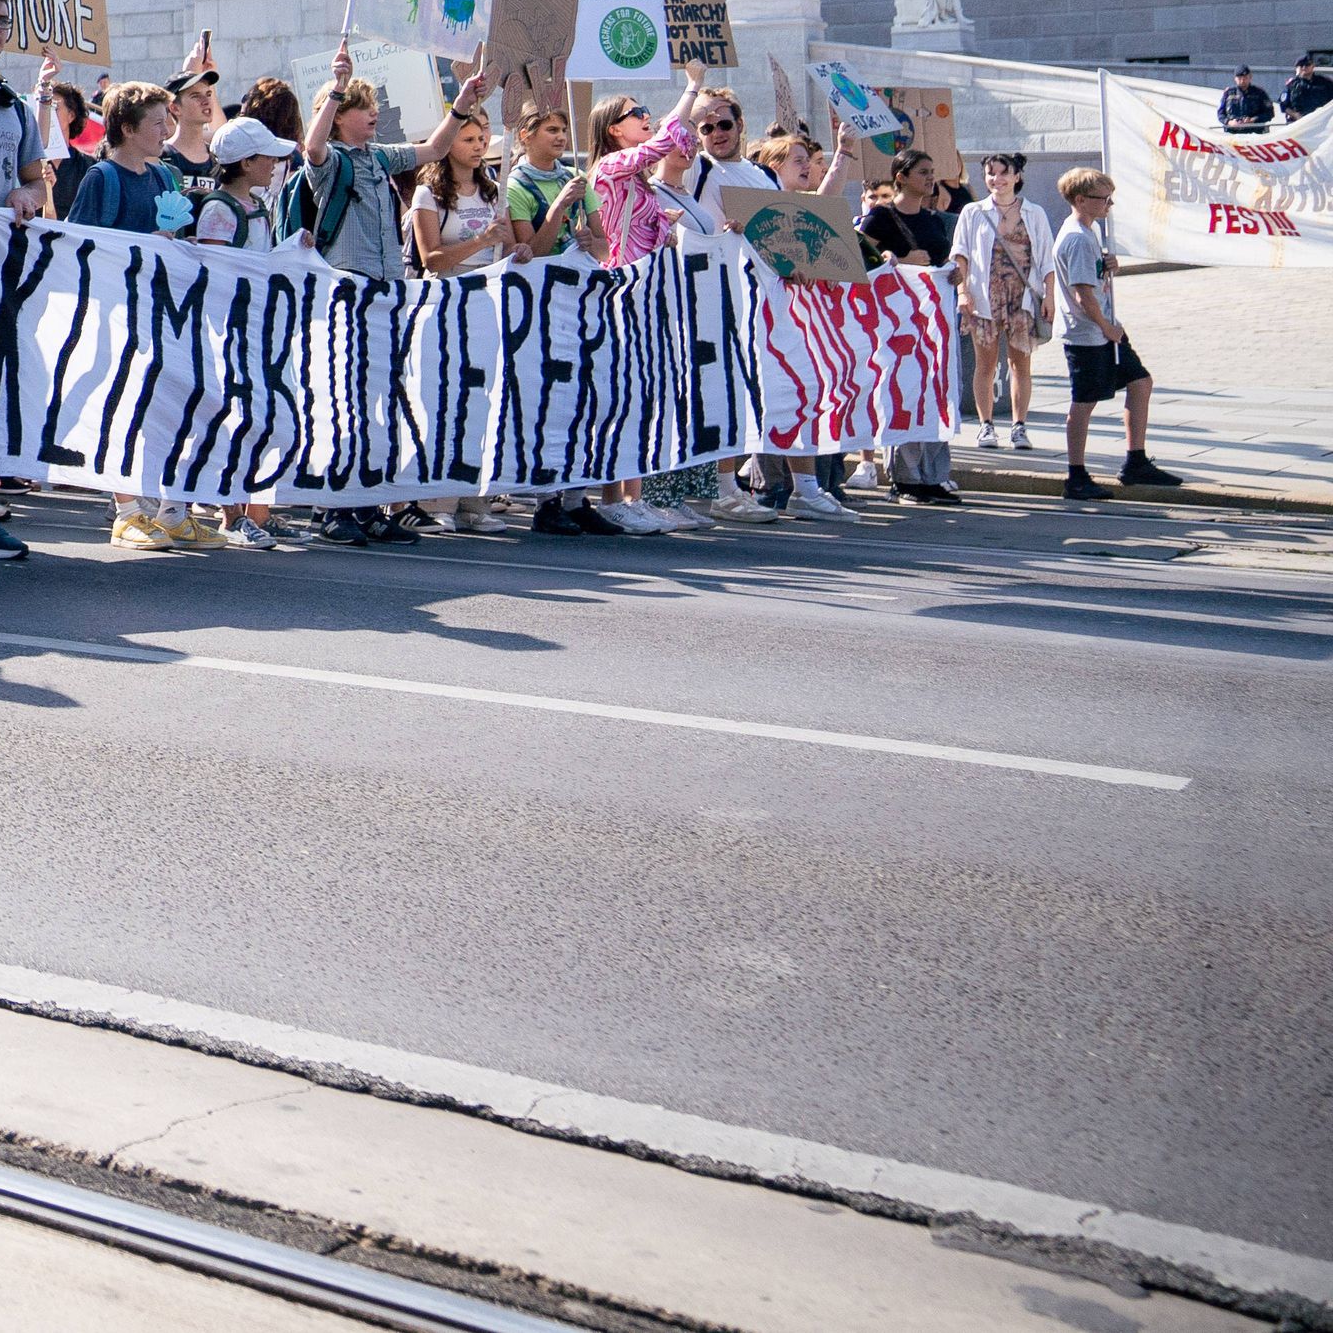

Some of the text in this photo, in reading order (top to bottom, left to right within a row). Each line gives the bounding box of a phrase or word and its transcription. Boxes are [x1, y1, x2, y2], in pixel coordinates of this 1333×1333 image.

[601, 9, 655, 55] TEACHERS FOR FUTURE
[694, 24, 723, 39] THE
[1234, 138, 1308, 163] EUCH
